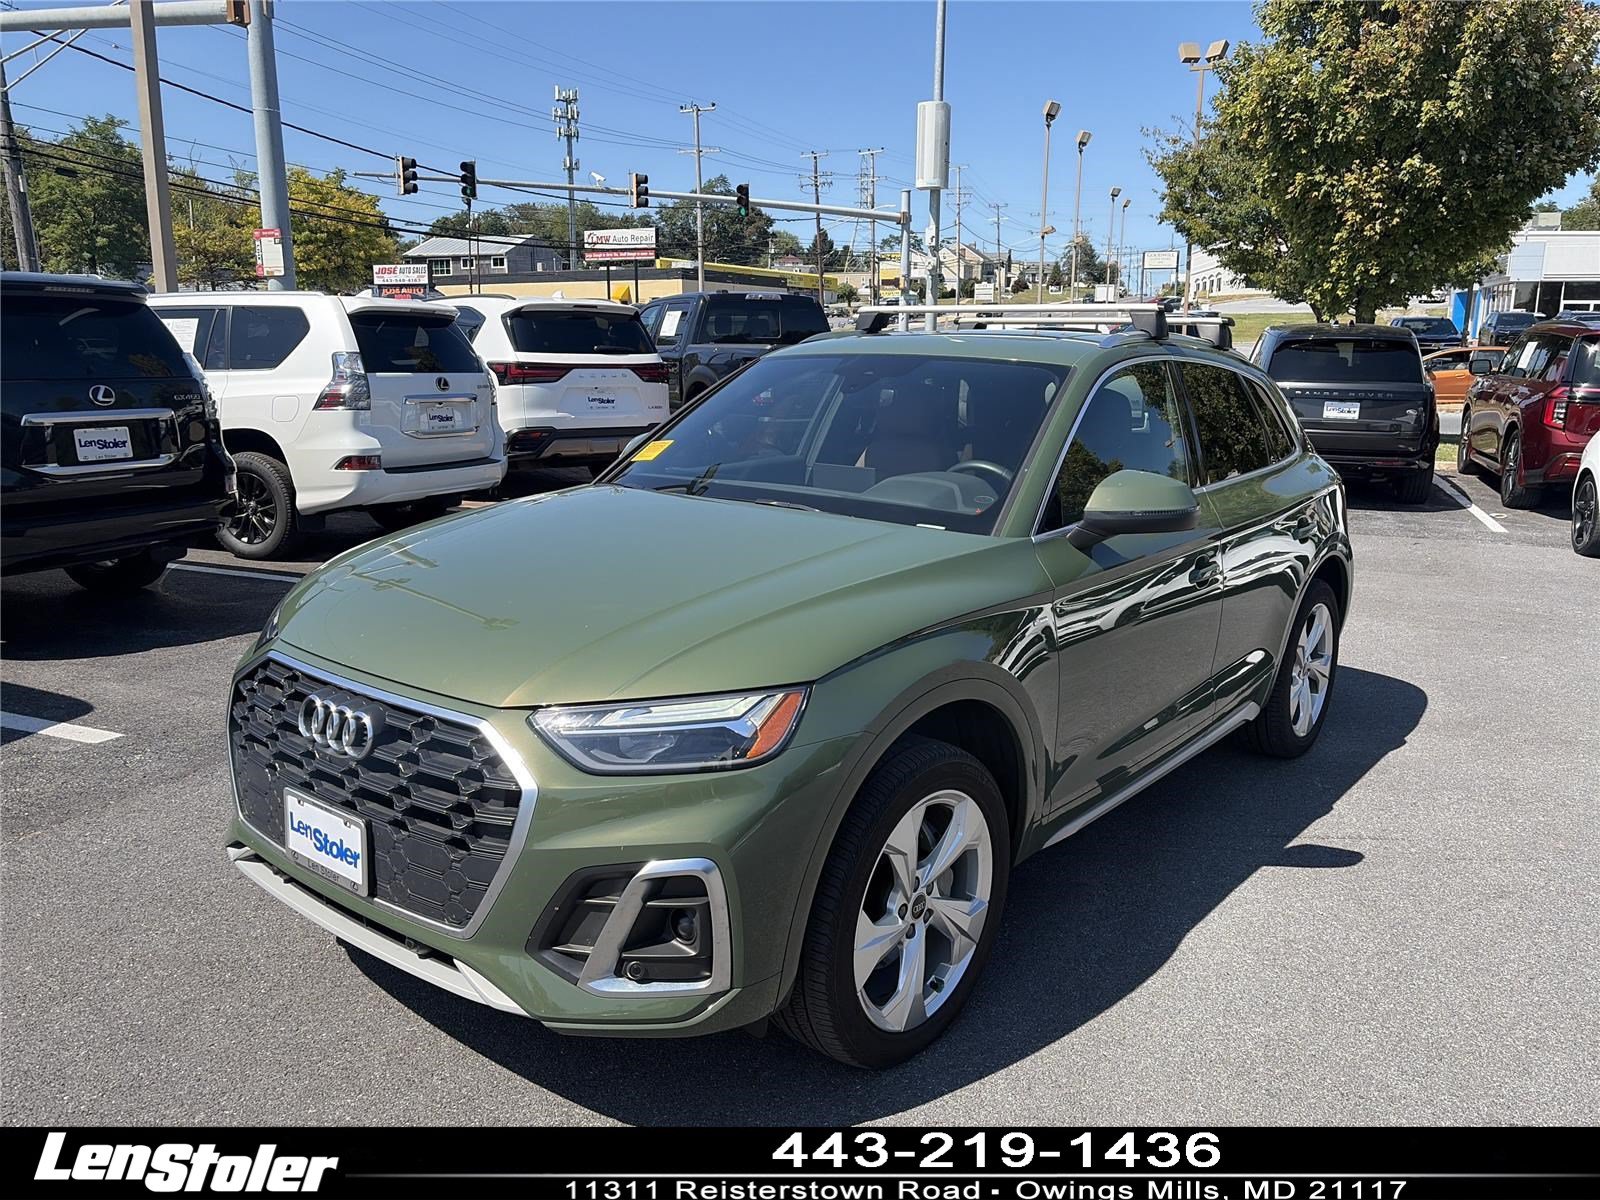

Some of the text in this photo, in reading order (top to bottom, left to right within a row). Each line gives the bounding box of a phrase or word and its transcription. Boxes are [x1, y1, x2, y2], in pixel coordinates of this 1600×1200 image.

[612, 235, 629, 243] Auto
[631, 234, 653, 244] Repair
[399, 266, 411, 274] AUTO
[412, 266, 426, 274] SALES
[308, 860, 340, 882] Len Stoler
